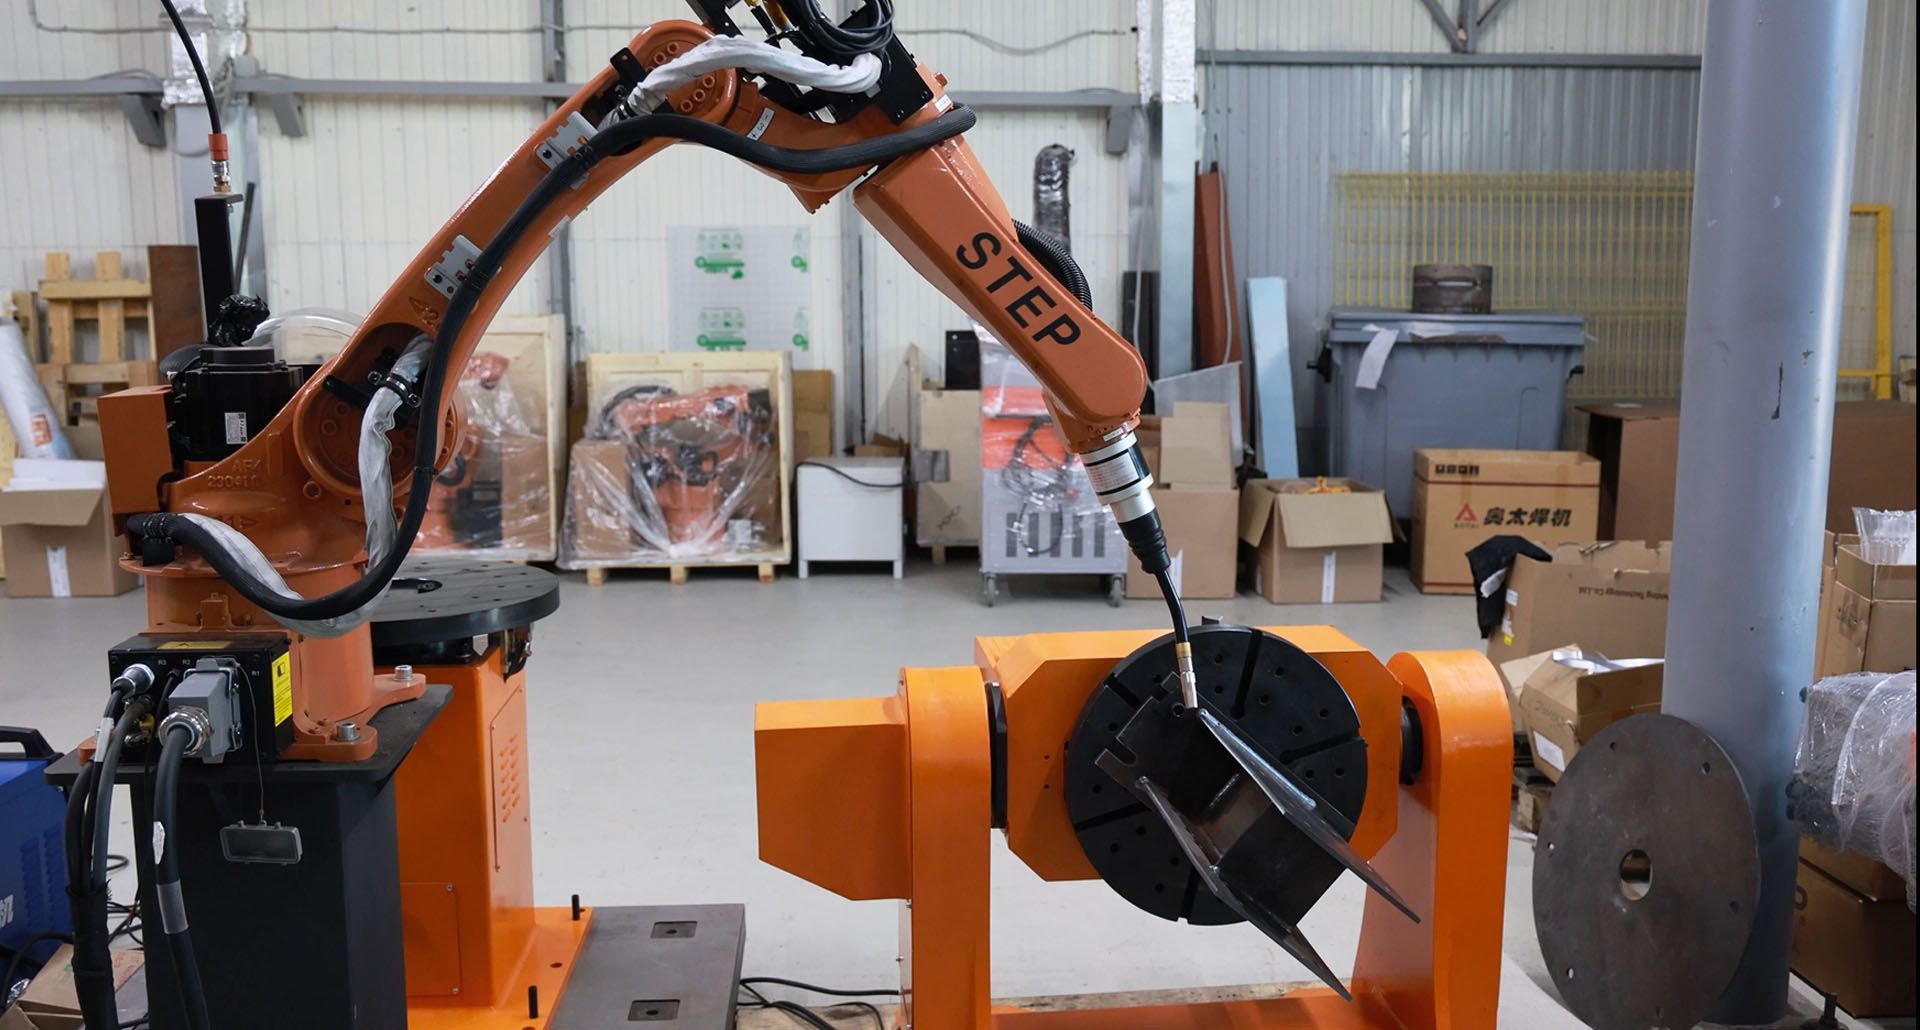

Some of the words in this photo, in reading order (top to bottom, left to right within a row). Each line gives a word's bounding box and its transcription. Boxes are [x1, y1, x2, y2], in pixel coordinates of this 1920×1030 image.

[956, 232, 1081, 345] STEP
[1483, 507, 1572, 527] 奥太焊机
